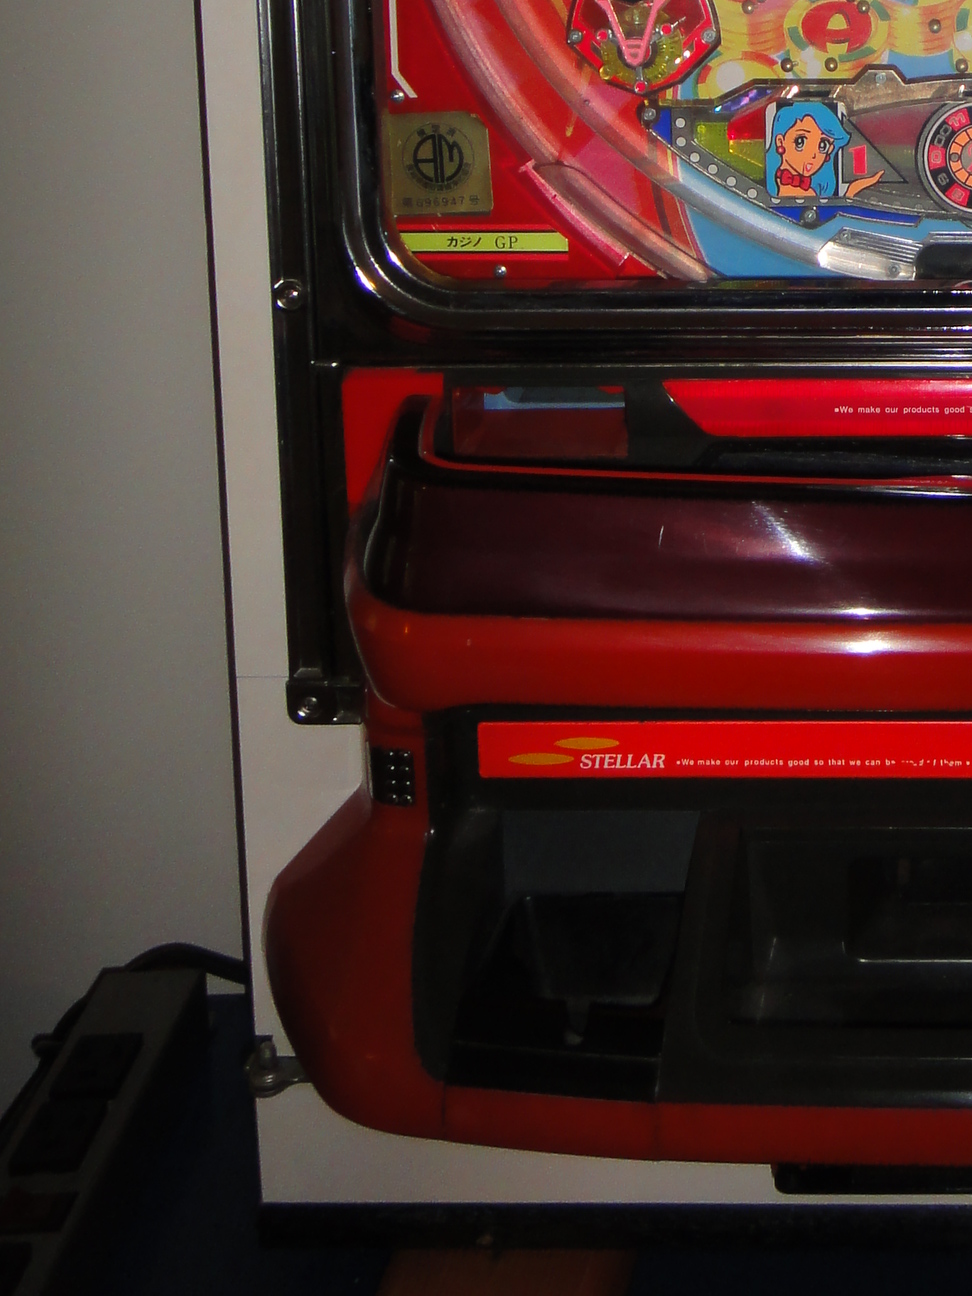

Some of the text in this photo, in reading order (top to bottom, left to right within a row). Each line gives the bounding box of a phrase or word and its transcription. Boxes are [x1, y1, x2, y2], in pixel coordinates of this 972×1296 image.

[848, 144, 867, 176] 1
[447, 236, 519, 250] カジノ GP
[840, 405, 854, 414] We
[857, 405, 881, 414] make
[885, 406, 899, 414] our
[903, 405, 940, 415] products
[944, 405, 965, 415] good
[580, 753, 666, 769] STELLAR
[681, 758, 695, 766] We
[697, 758, 721, 766] make
[744, 758, 784, 767] products
[788, 758, 810, 767] good
[828, 758, 845, 766] that
